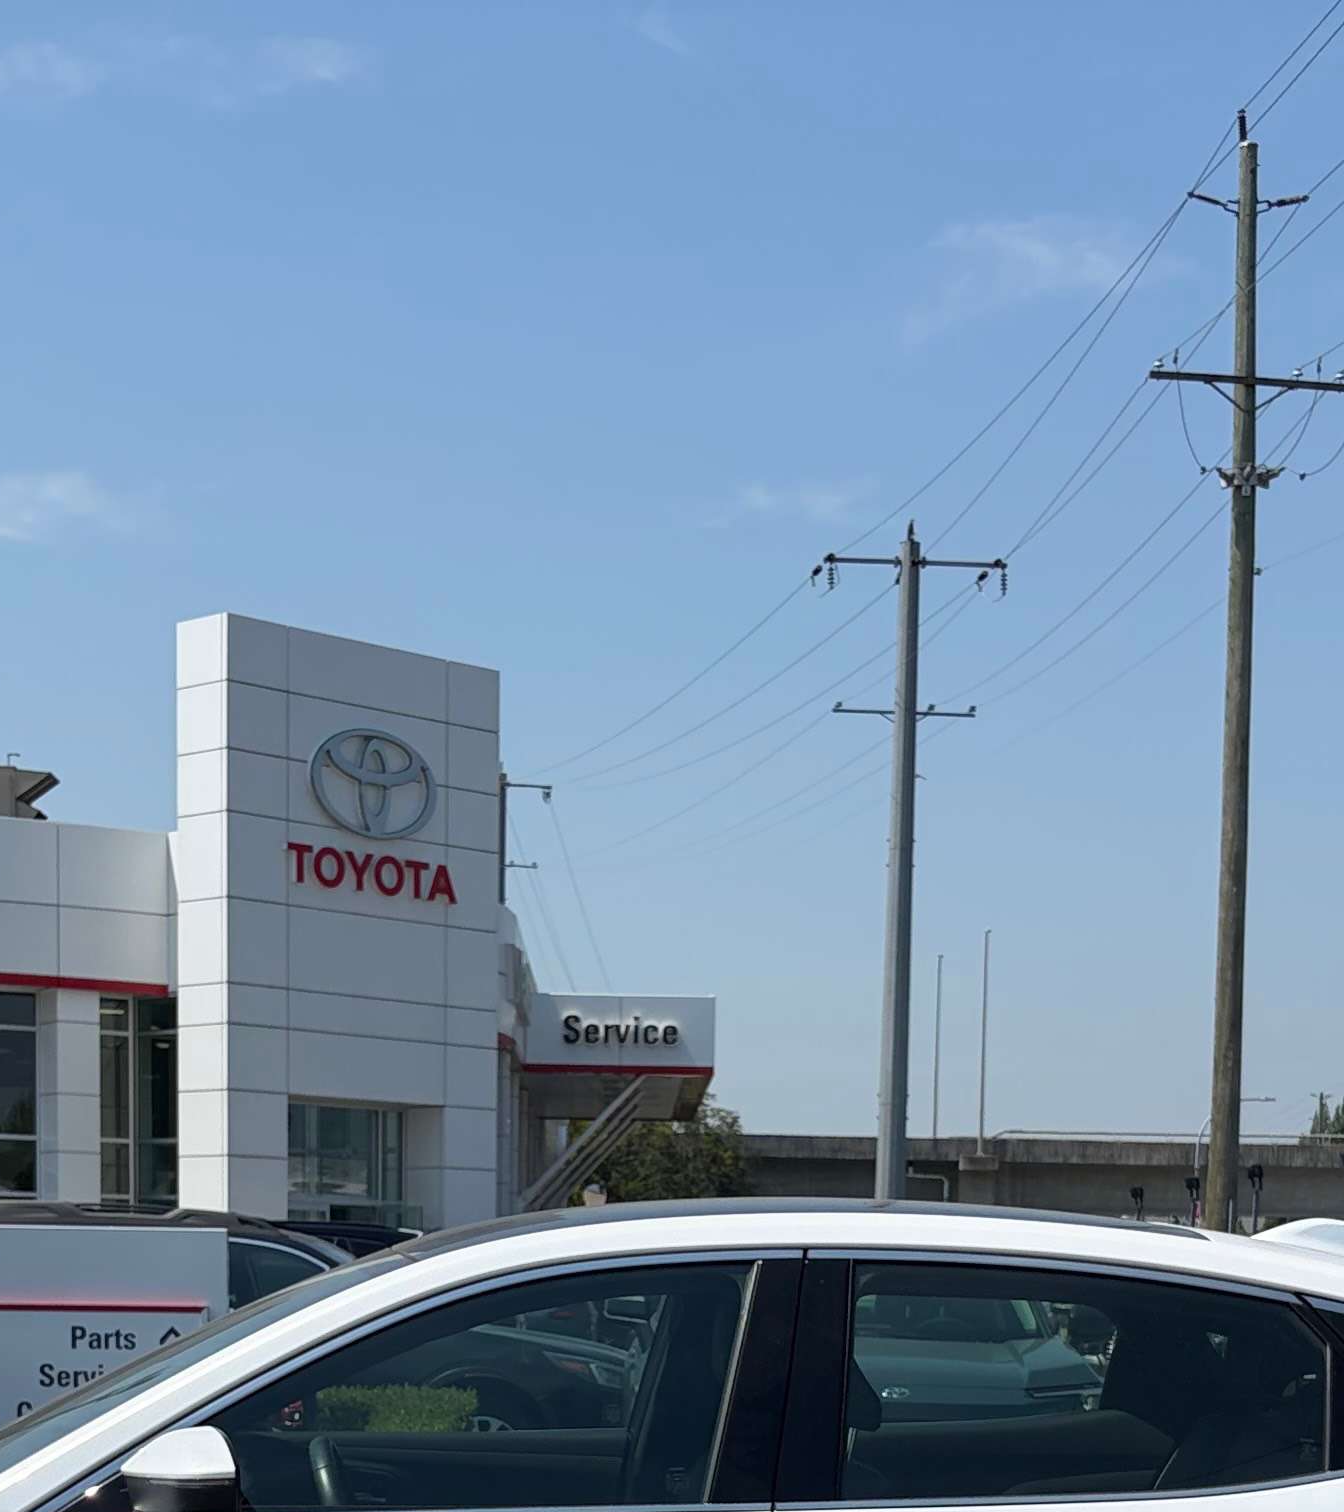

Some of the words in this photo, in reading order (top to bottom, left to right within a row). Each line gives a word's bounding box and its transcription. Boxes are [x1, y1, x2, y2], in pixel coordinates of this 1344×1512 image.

[286, 842, 458, 905] TOYOTA
[562, 1014, 680, 1047] Service
[71, 1325, 137, 1350] Parts
